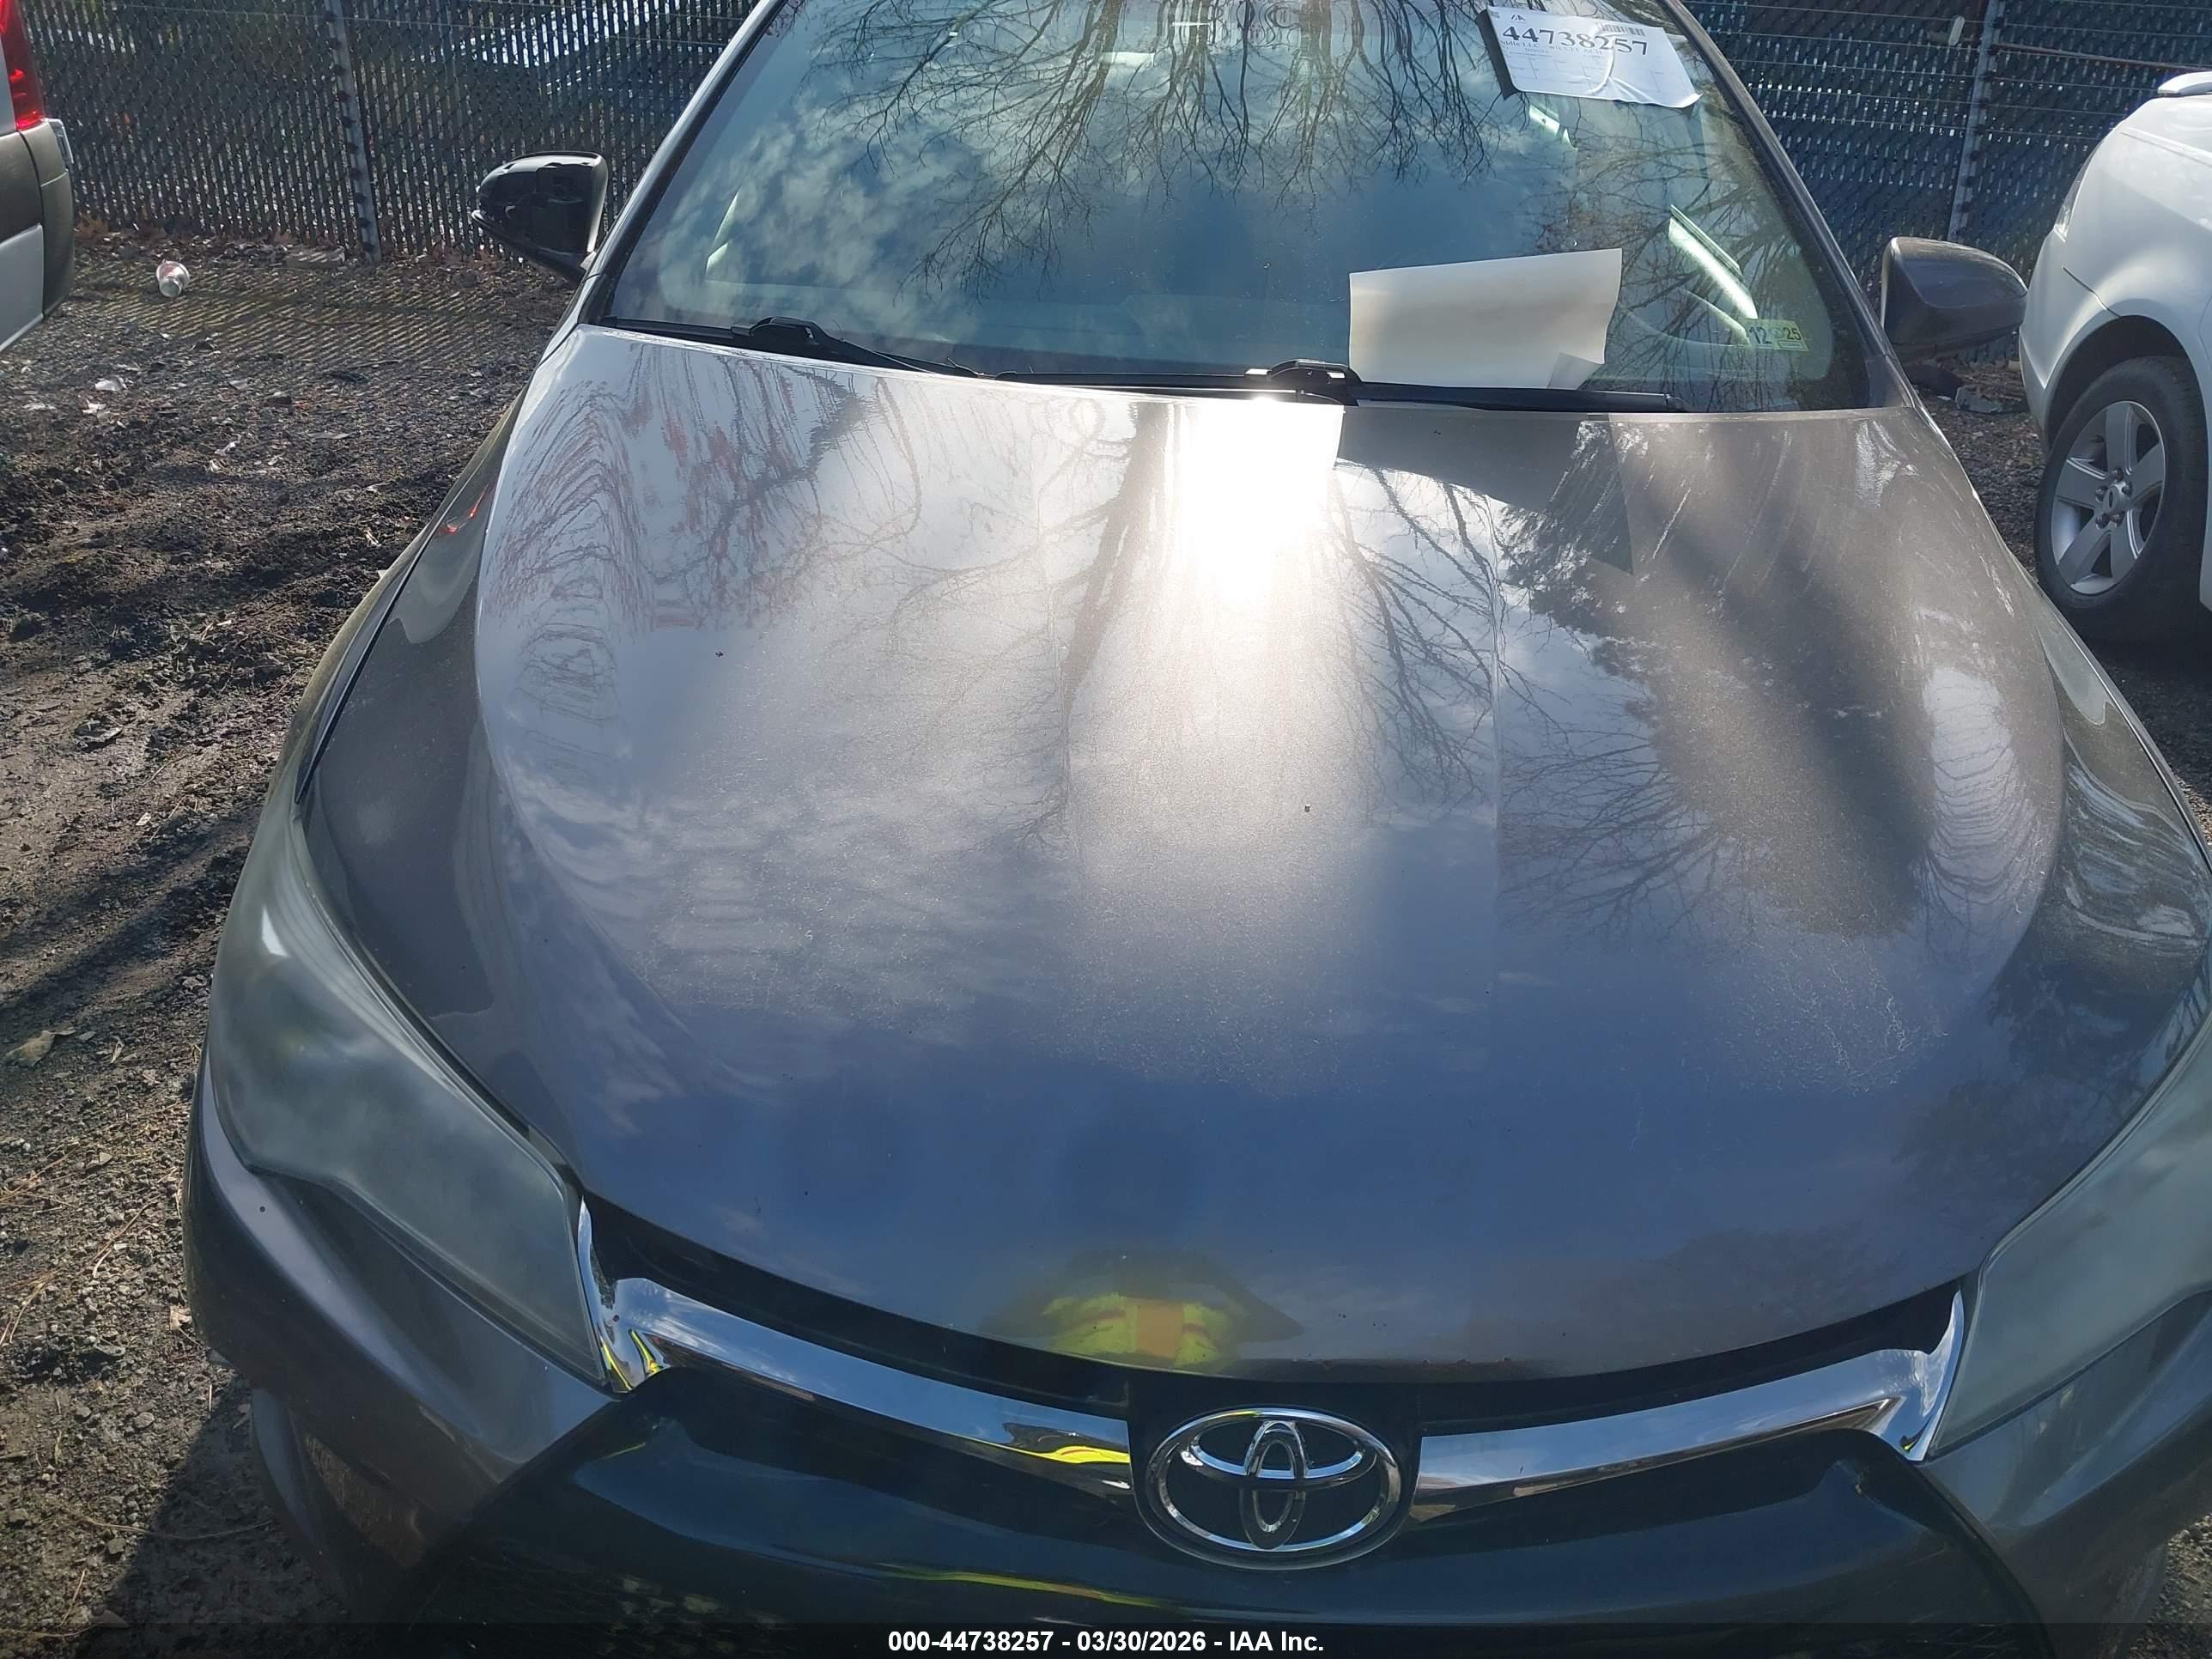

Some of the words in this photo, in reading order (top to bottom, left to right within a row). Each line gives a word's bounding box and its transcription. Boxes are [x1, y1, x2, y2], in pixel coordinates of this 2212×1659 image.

[1503, 26, 1647, 55] 44738257
[1749, 326, 1772, 344] 12
[1783, 327, 1802, 340] 25
